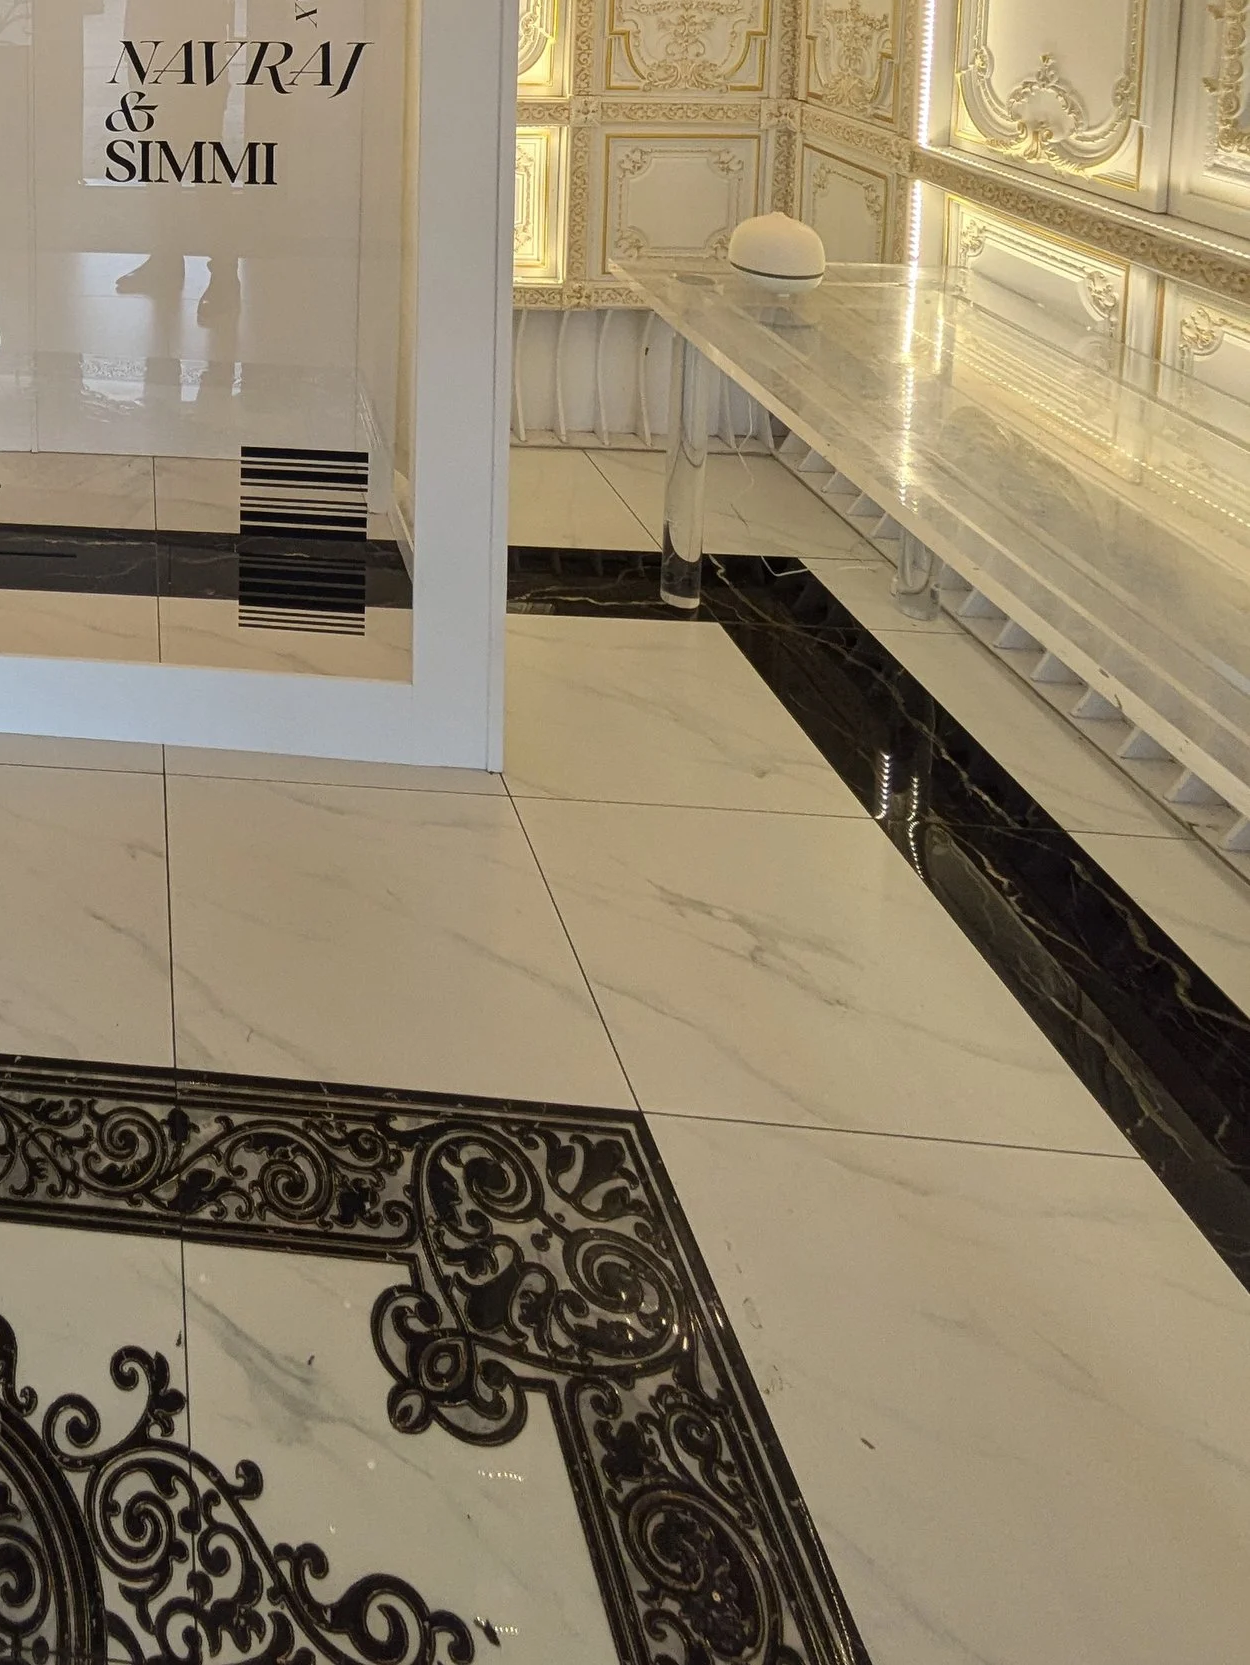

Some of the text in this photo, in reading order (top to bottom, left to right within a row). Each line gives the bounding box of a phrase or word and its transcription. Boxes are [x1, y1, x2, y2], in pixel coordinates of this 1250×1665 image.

[109, 40, 374, 95] NAVRAJ
[104, 91, 158, 133] &
[104, 139, 279, 186] SIMMI
